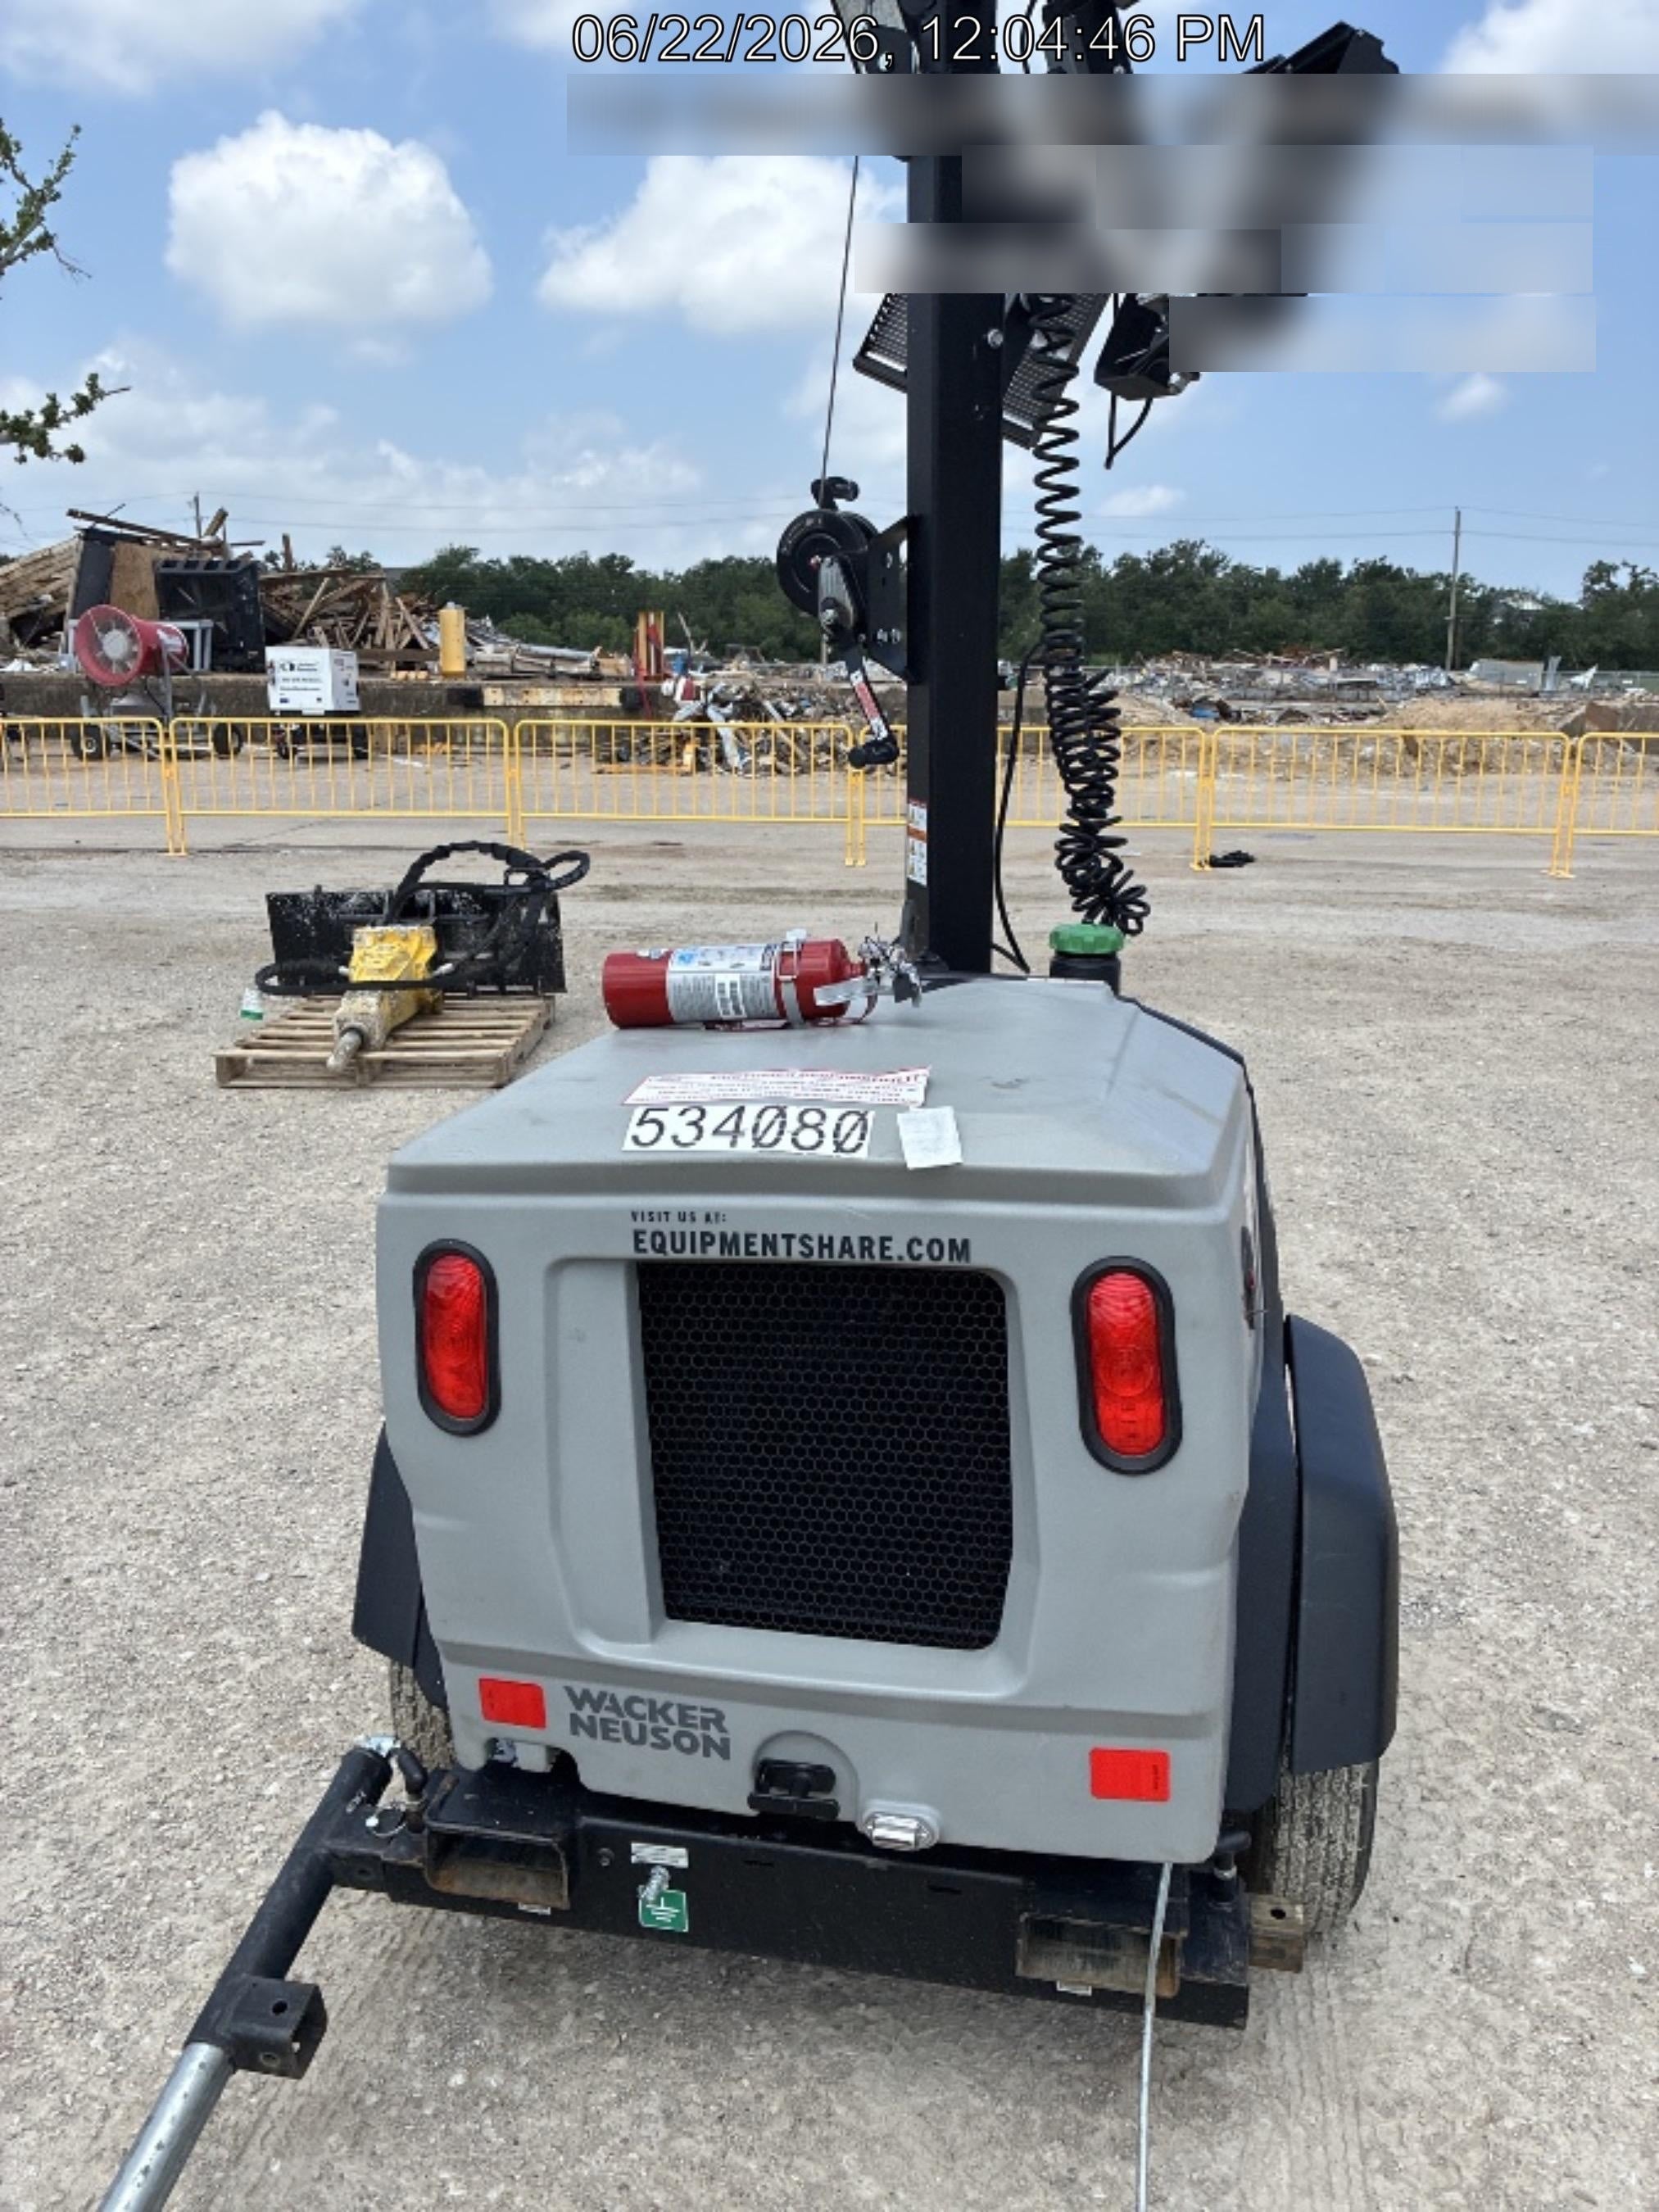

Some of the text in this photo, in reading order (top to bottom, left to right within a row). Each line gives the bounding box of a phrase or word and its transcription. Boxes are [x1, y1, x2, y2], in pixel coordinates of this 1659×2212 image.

[631, 1104, 869, 1154] 534080
[630, 1210, 670, 1222] VISIT
[678, 1211, 696, 1223] US
[632, 1229, 972, 1263] EQUIPMENTSHARE.COM
[565, 1685, 728, 1734] WACKER
[570, 1712, 731, 1761] NEUSON
